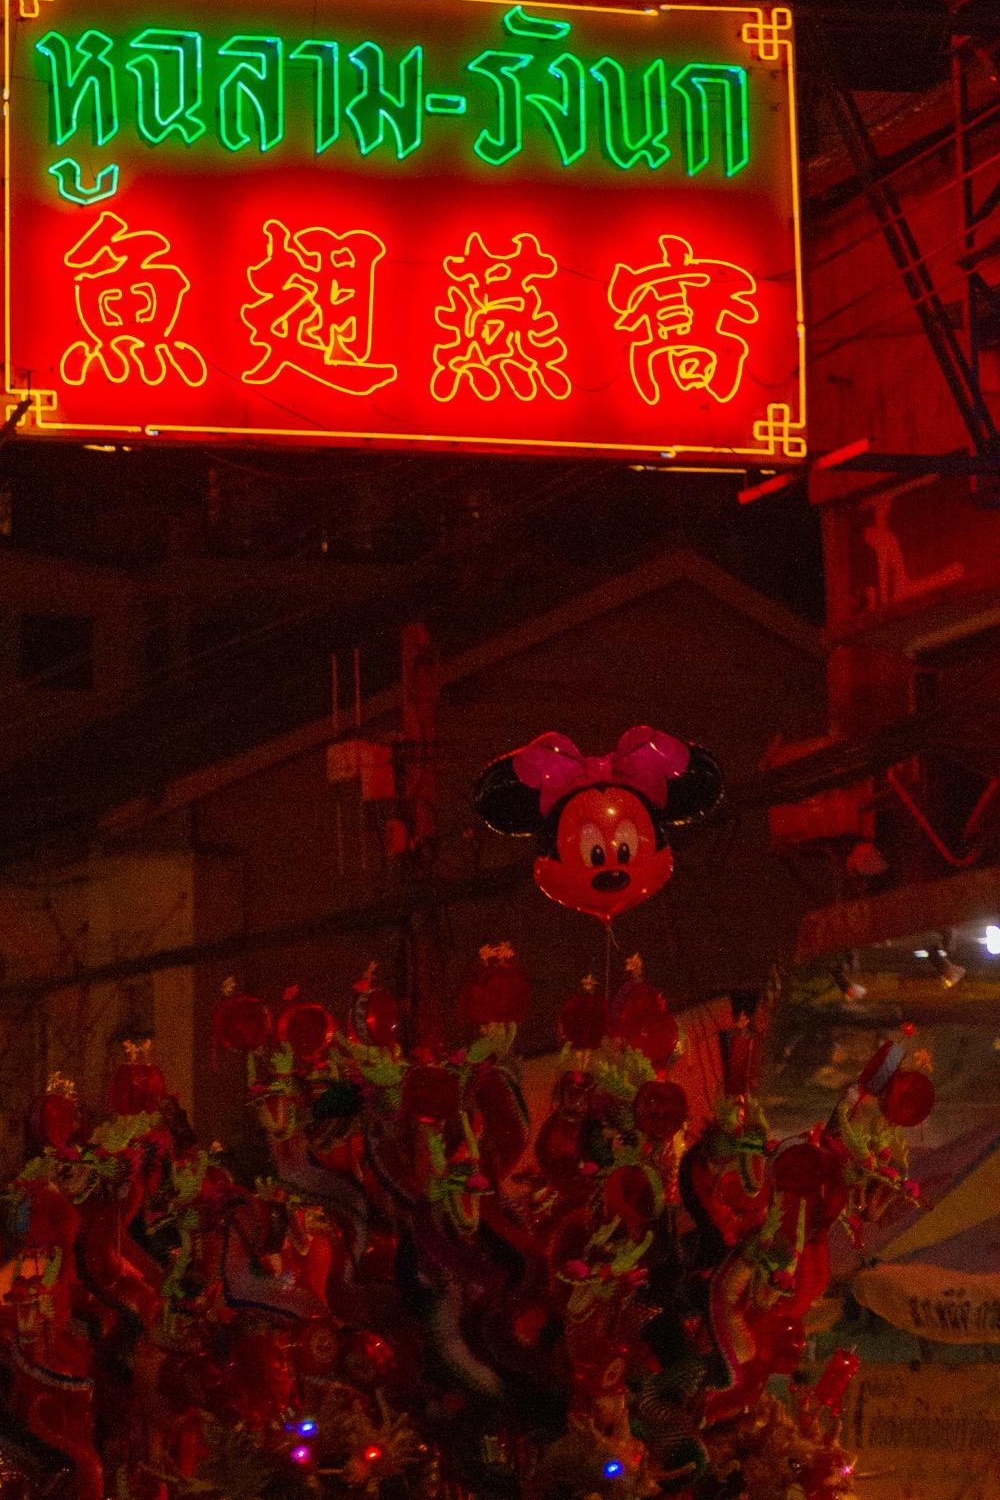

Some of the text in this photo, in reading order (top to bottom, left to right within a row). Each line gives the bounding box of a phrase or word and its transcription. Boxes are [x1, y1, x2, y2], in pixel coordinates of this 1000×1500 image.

[35, 4, 749, 205] หูฉลาม-รังนก
[59, 209, 760, 406] 魚翅燕窩
